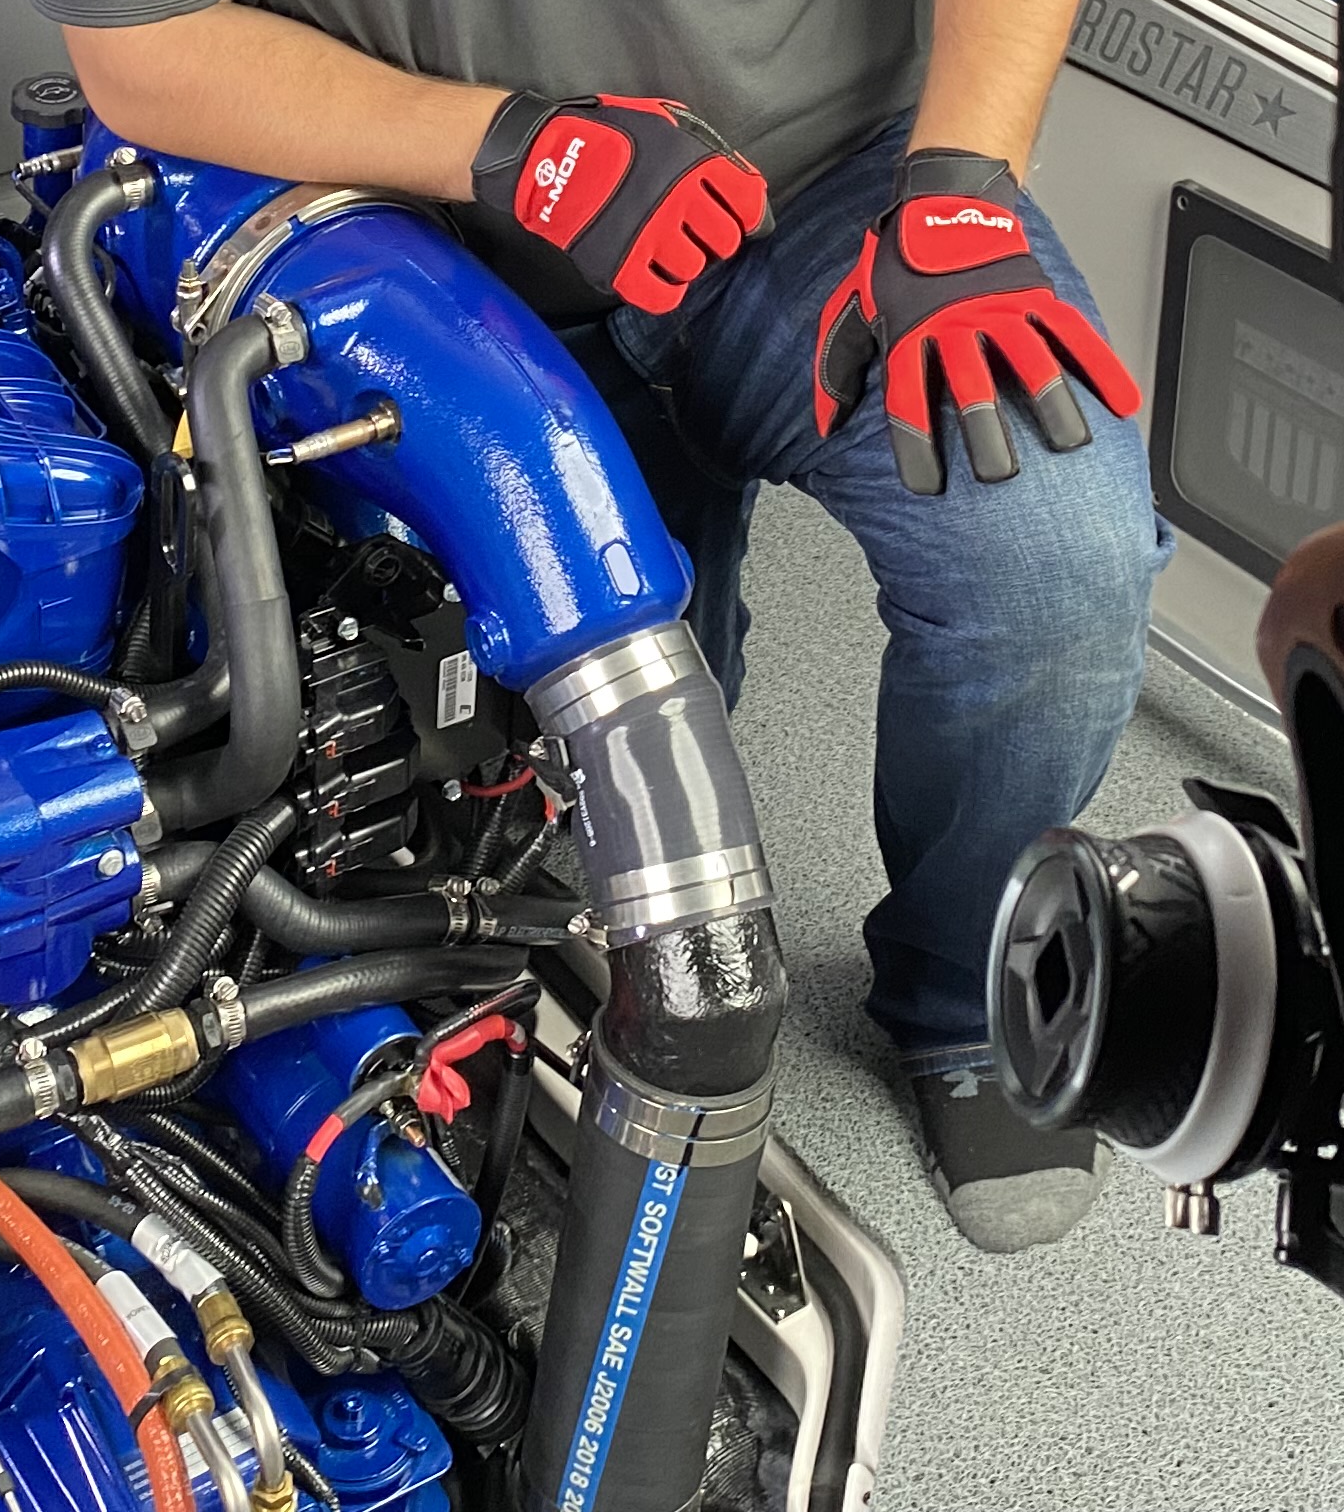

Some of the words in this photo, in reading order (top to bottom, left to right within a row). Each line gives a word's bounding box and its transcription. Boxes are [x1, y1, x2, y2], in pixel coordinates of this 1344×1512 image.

[539, 137, 586, 223] ILMOR
[652, 1161, 680, 1196] ST
[615, 1200, 667, 1318] SOFTWALL
[602, 1323, 633, 1371] SAE
[583, 1371, 617, 1436] J2006
[569, 1435, 599, 1489] 2018
